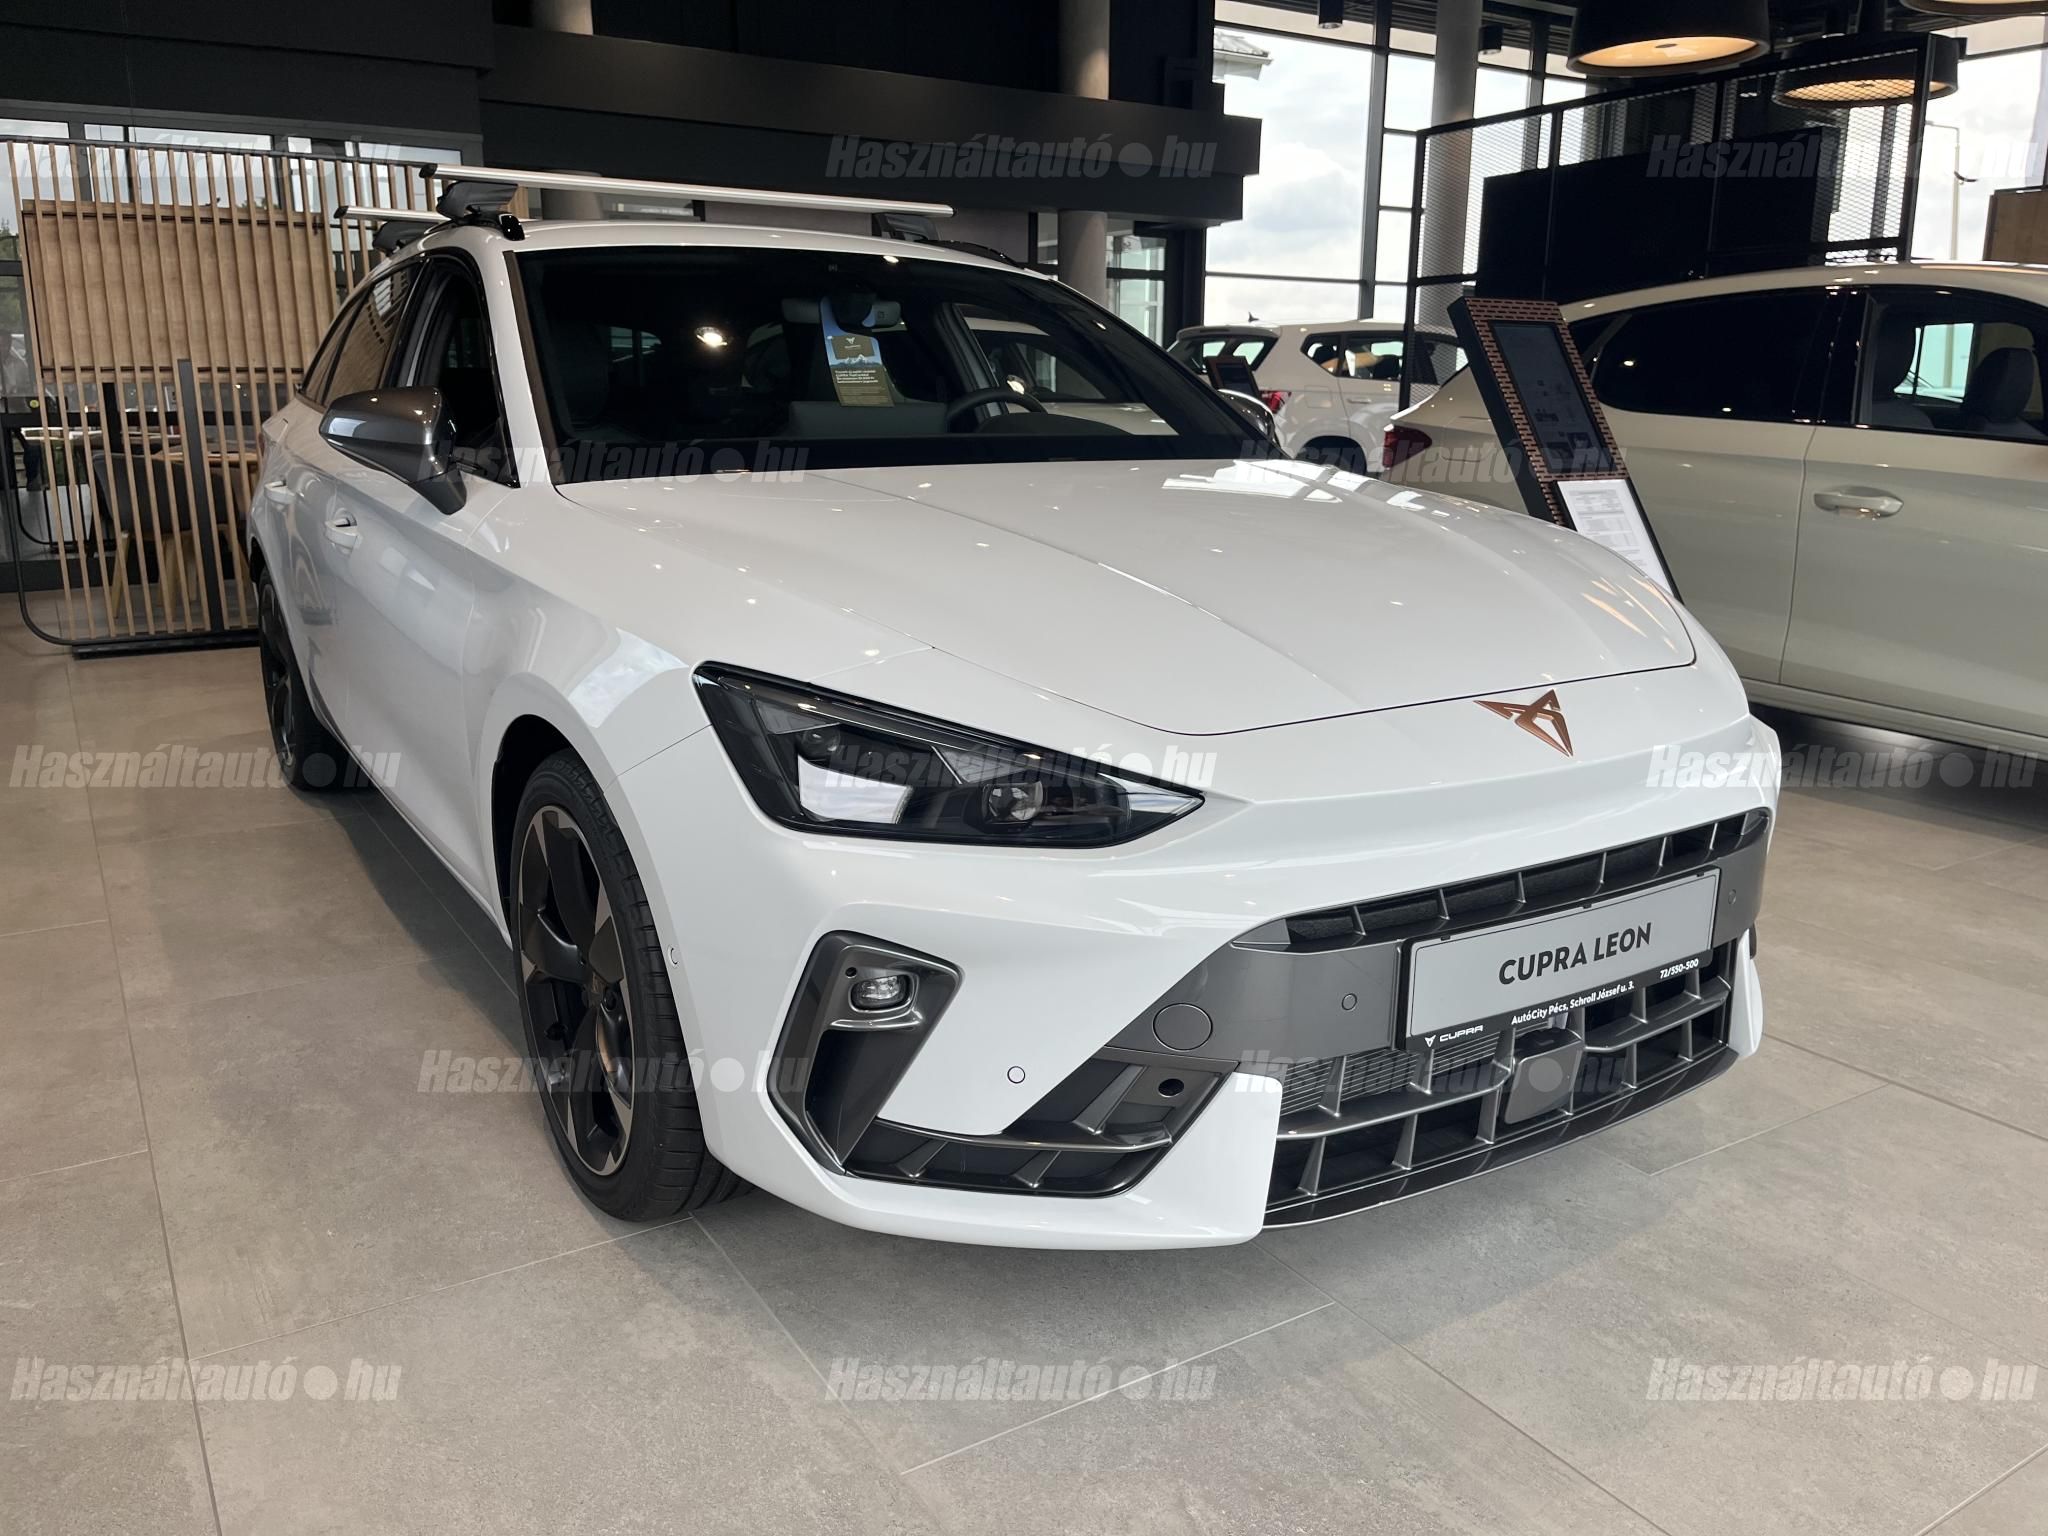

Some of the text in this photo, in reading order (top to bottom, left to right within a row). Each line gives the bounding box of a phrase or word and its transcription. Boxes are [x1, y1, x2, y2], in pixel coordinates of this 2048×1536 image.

[1499, 923, 1652, 985] CUPRA LEON
[1511, 1007, 1548, 1025] AutóCity
[1548, 1002, 1569, 1016] Pécs,
[1570, 992, 1597, 1009] Schroll
[1596, 984, 1621, 1001] József
[1439, 1024, 1484, 1043] CUPRA
